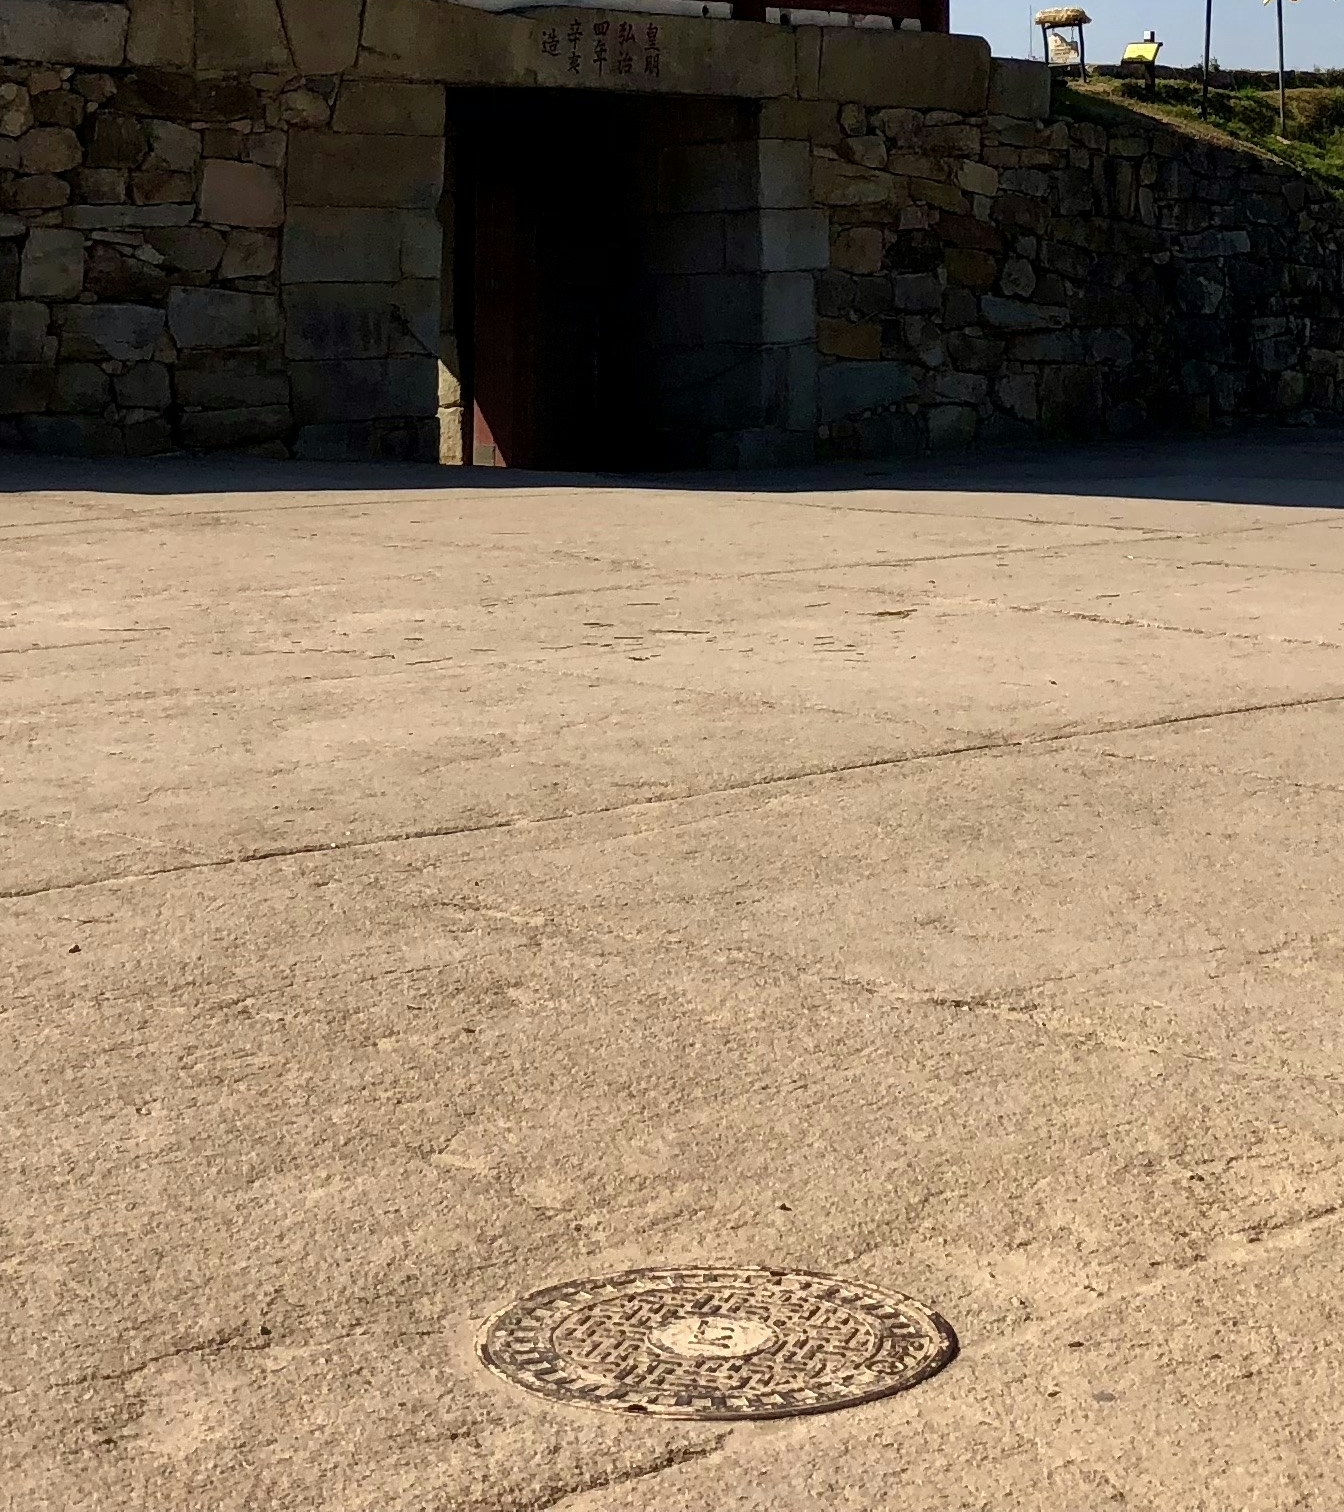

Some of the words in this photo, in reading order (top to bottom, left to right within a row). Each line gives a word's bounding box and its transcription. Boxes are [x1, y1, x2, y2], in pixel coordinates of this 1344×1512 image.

[542, 28, 561, 56] 造
[567, 18, 583, 75] 辛亥
[593, 20, 610, 77] 四年
[618, 21, 636, 75] 弘治
[644, 22, 660, 78] 皇明
